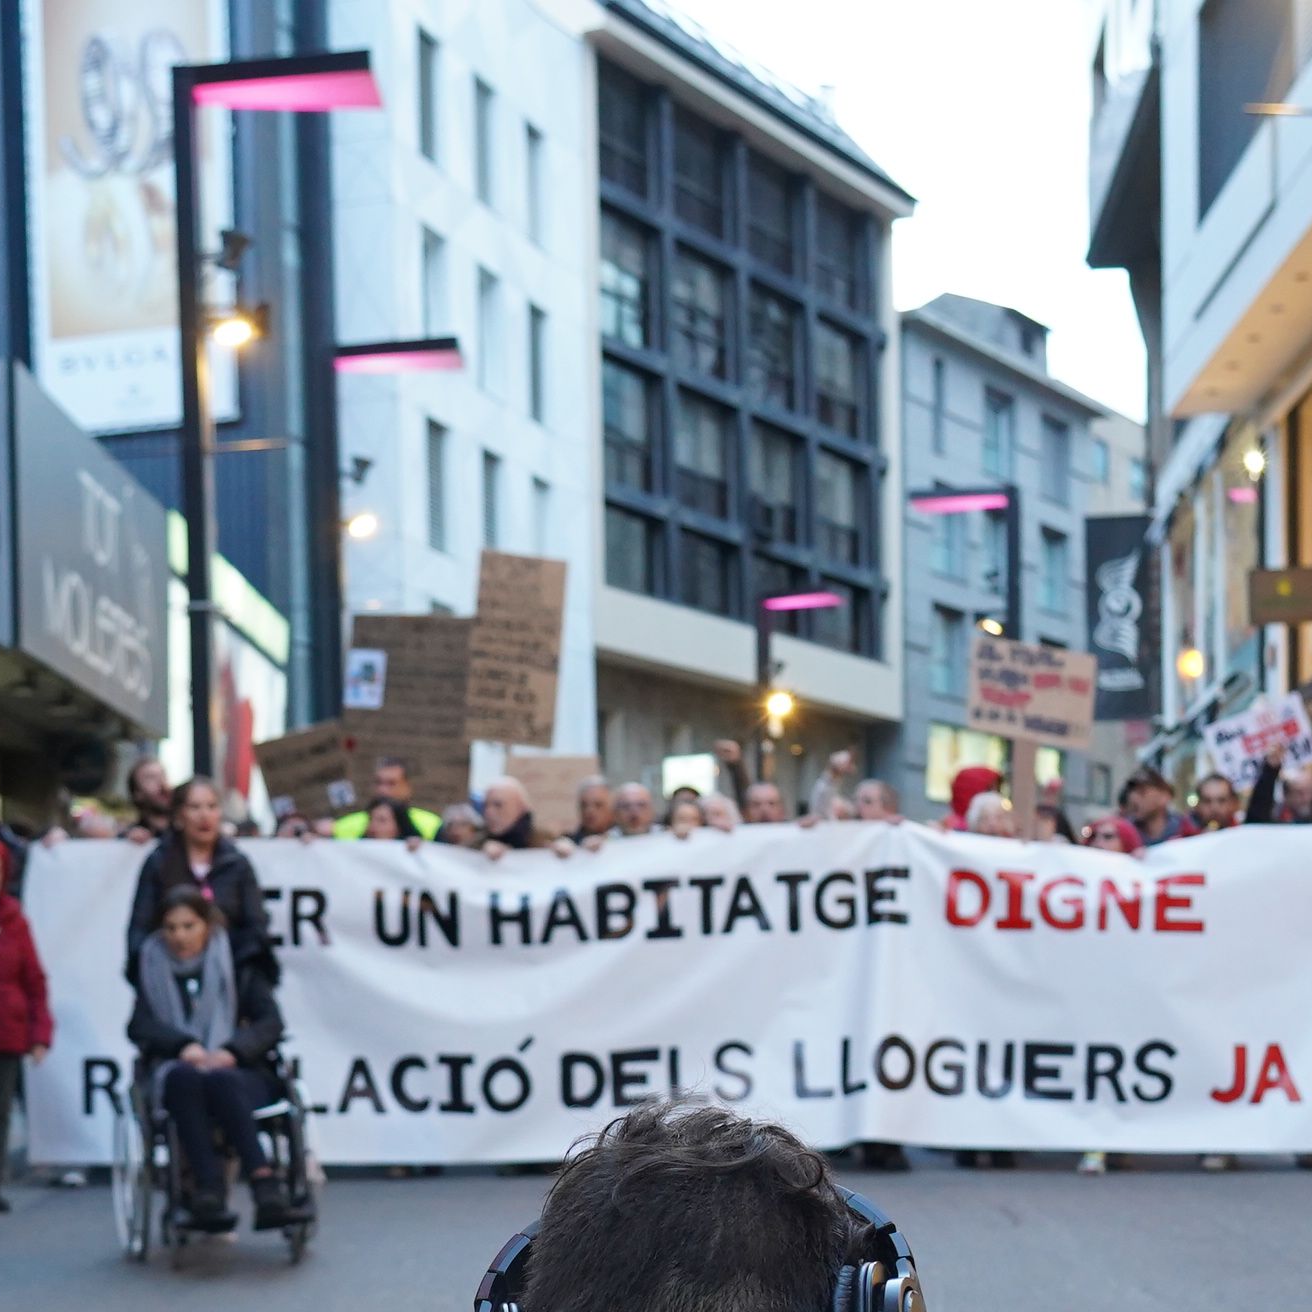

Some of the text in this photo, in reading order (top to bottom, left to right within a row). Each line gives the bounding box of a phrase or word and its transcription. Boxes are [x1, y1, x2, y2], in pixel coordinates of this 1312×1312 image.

[373, 888, 460, 948] UN
[488, 866, 911, 948] HABITATGE
[944, 868, 1207, 932] DIGNE
[791, 1033, 1178, 1104] LLOGUERS
[1210, 1042, 1303, 1104] JA
